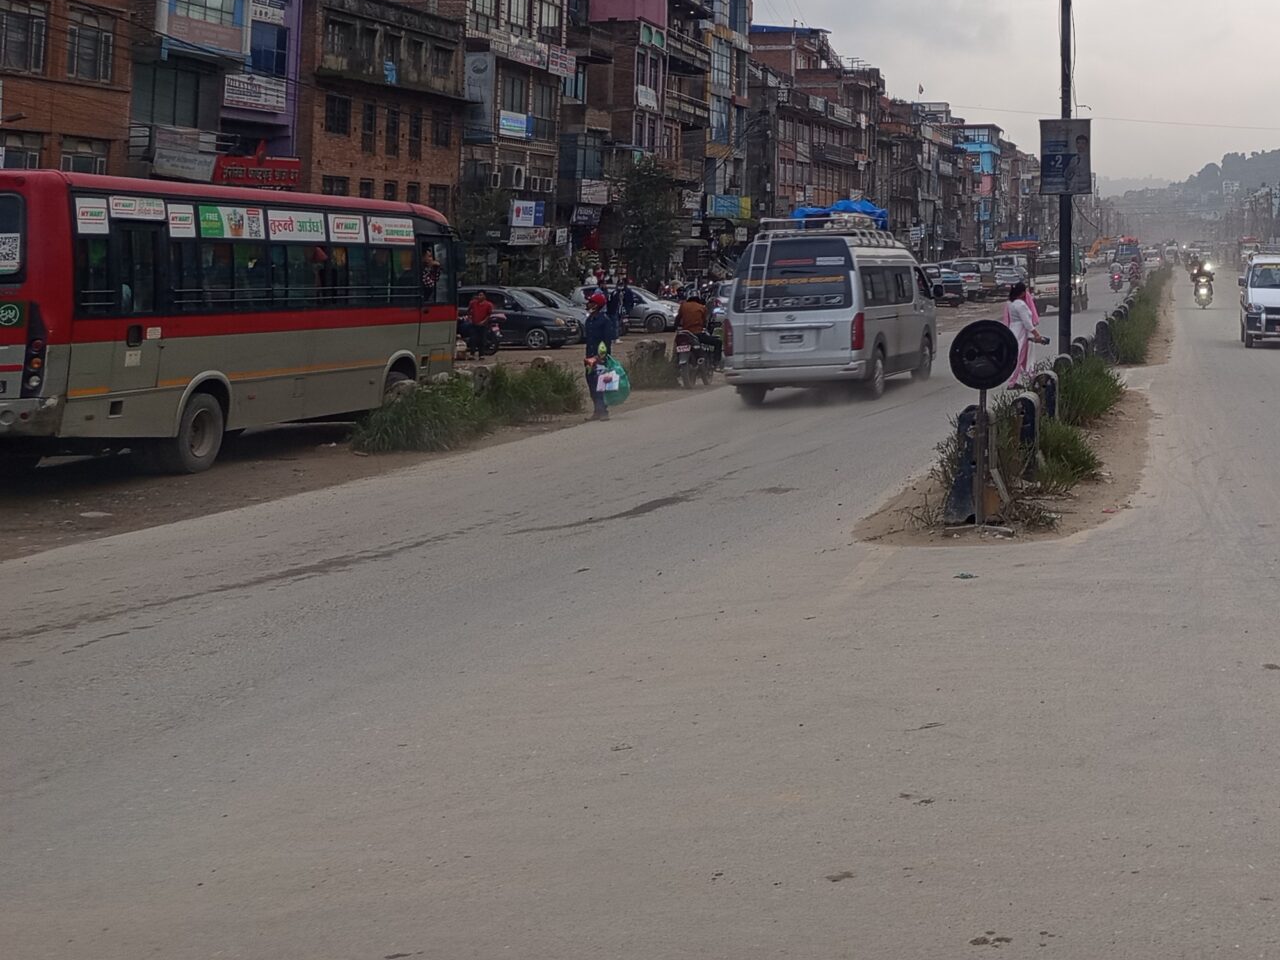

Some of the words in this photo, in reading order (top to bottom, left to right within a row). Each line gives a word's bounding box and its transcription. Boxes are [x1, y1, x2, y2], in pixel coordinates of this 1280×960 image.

[80, 210, 89, 218] MY
[89, 210, 104, 218] MART
[205, 212, 218, 221] FREE
[171, 215, 178, 223] MY
[178, 215, 191, 223] MART
[335, 222, 344, 230] MY
[344, 222, 358, 230] MART
